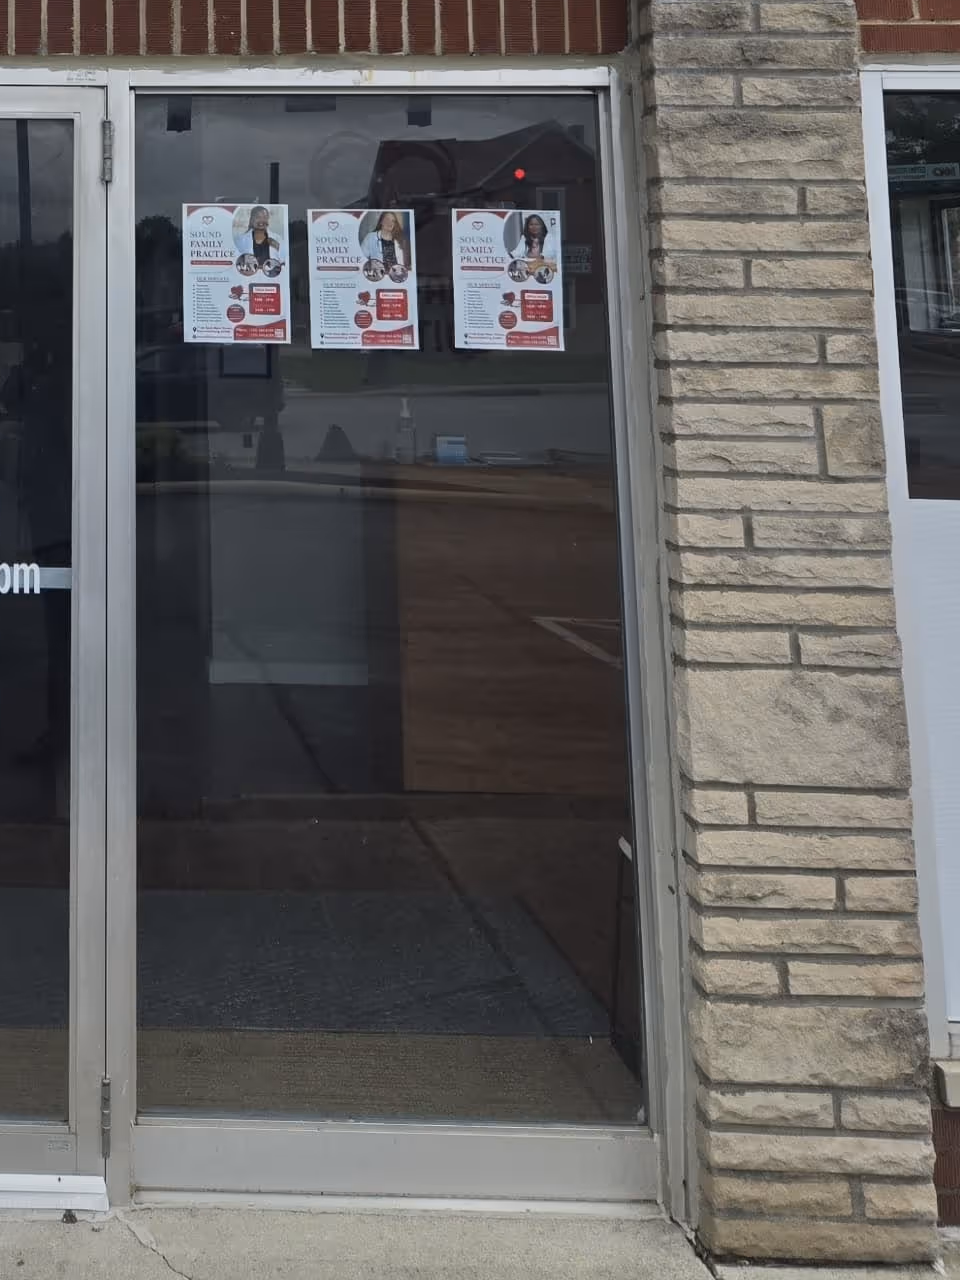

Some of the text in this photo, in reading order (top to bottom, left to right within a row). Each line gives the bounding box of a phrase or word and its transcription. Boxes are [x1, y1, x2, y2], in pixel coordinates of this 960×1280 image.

[190, 231, 222, 239] SOUND
[190, 240, 223, 248] FAMILY
[315, 236, 349, 244] SOUND
[459, 236, 493, 244] SOUND
[190, 250, 236, 258] PRACTICE
[316, 246, 350, 254] FAMILY
[460, 246, 494, 254] FAMILY
[317, 256, 362, 264] PRACTICE
[460, 256, 507, 264] PRACTICE
